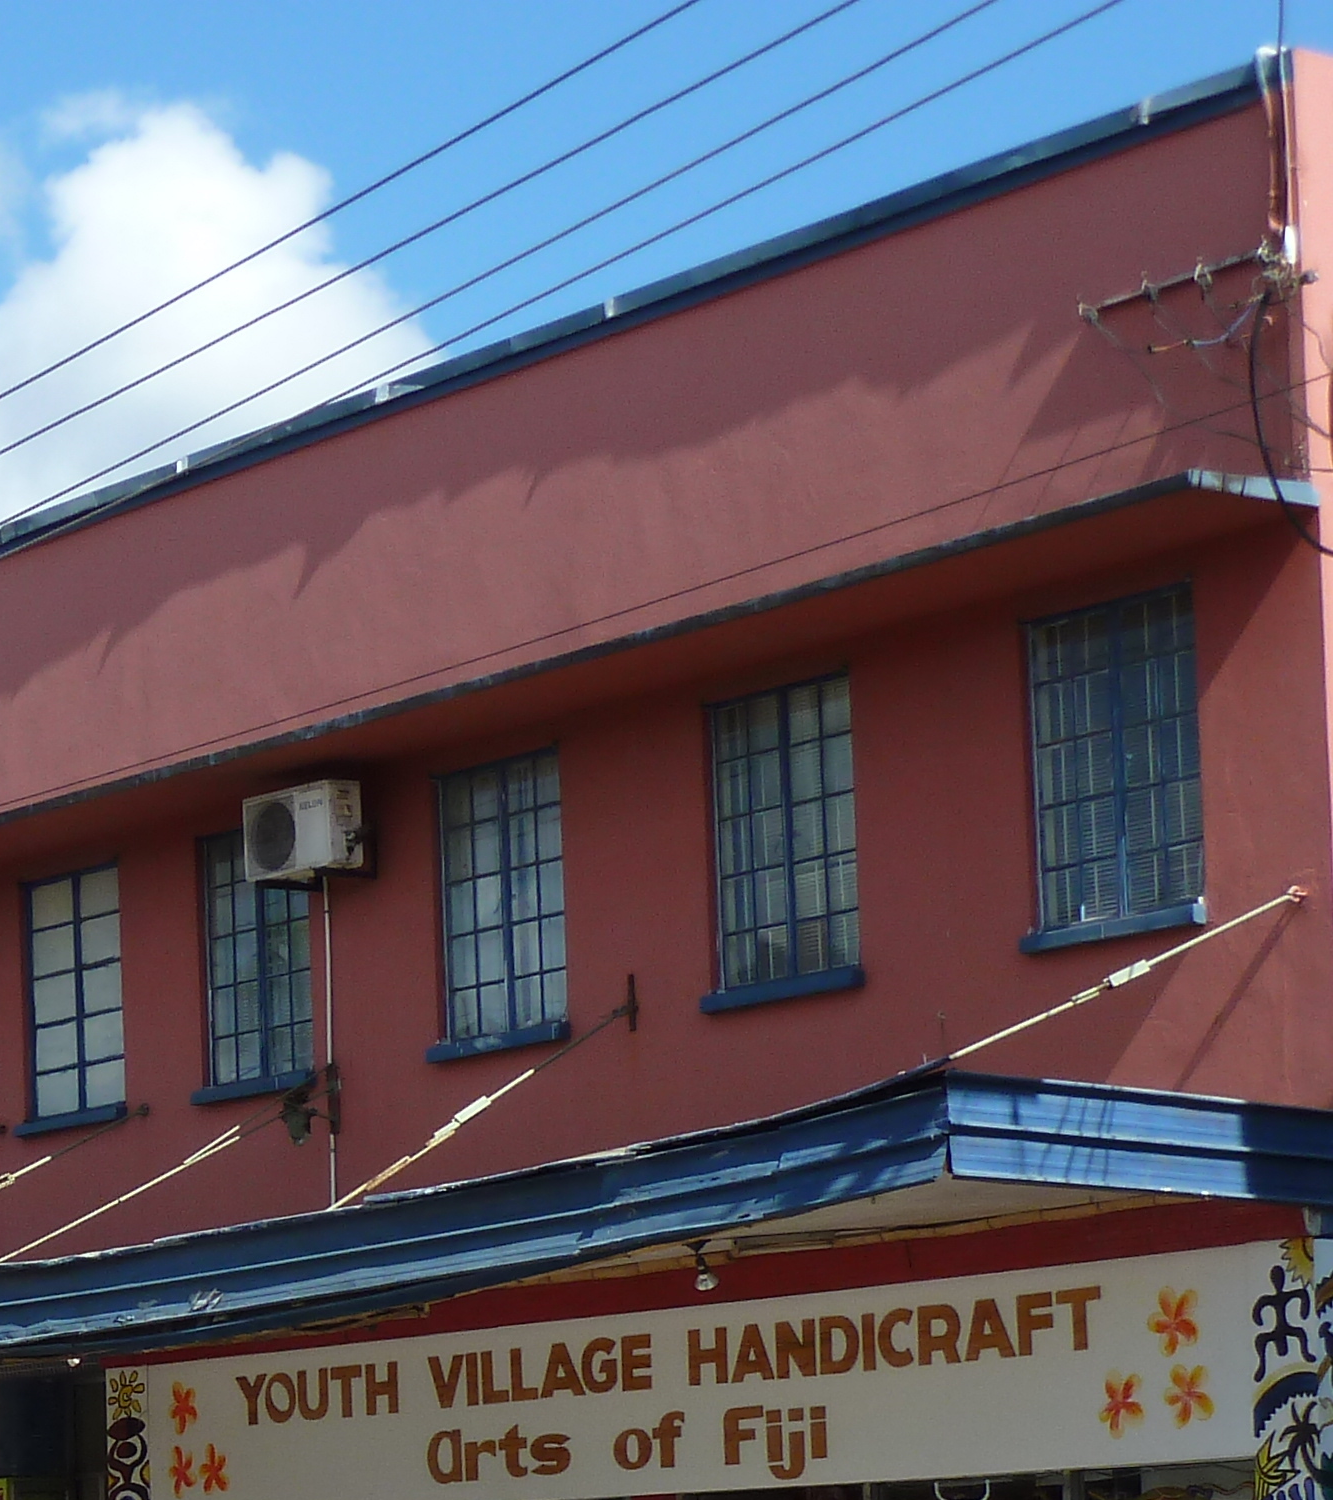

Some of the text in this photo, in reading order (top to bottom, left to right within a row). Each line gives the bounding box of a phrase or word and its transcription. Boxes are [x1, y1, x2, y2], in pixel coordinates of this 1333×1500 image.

[234, 1286, 1102, 1425] YOUTH VILLAGE HANDICRAFT
[613, 1411, 685, 1470] of
[723, 1405, 827, 1480] Fiji
